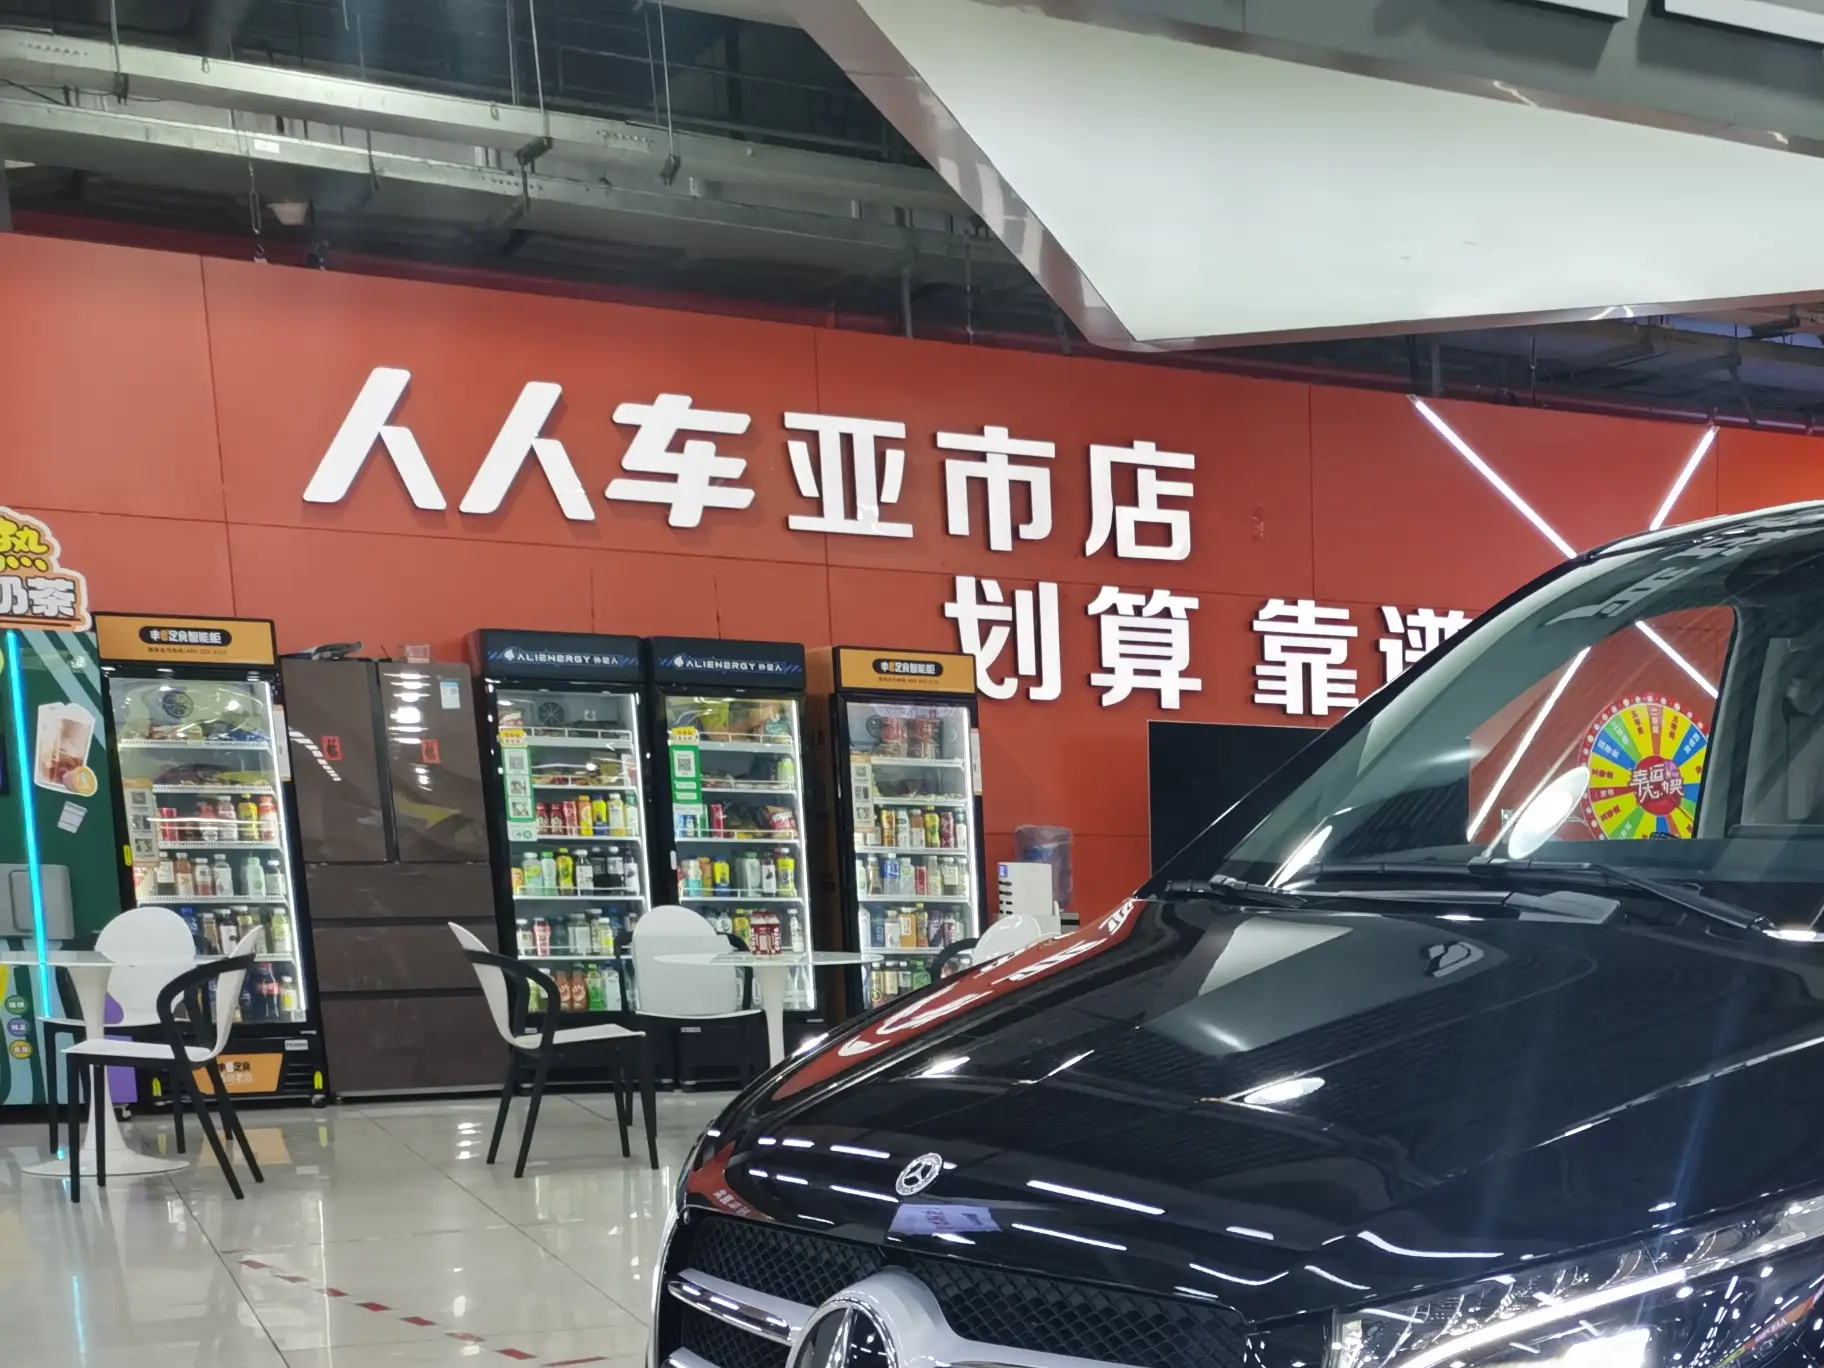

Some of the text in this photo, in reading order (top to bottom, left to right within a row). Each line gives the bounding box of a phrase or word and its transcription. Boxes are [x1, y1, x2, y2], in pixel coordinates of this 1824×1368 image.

[302, 366, 1196, 561] 人人车亚市店
[517, 652, 591, 664] ALIENERGY
[686, 659, 756, 671] ALIENERGY
[944, 574, 1203, 710] 划算
